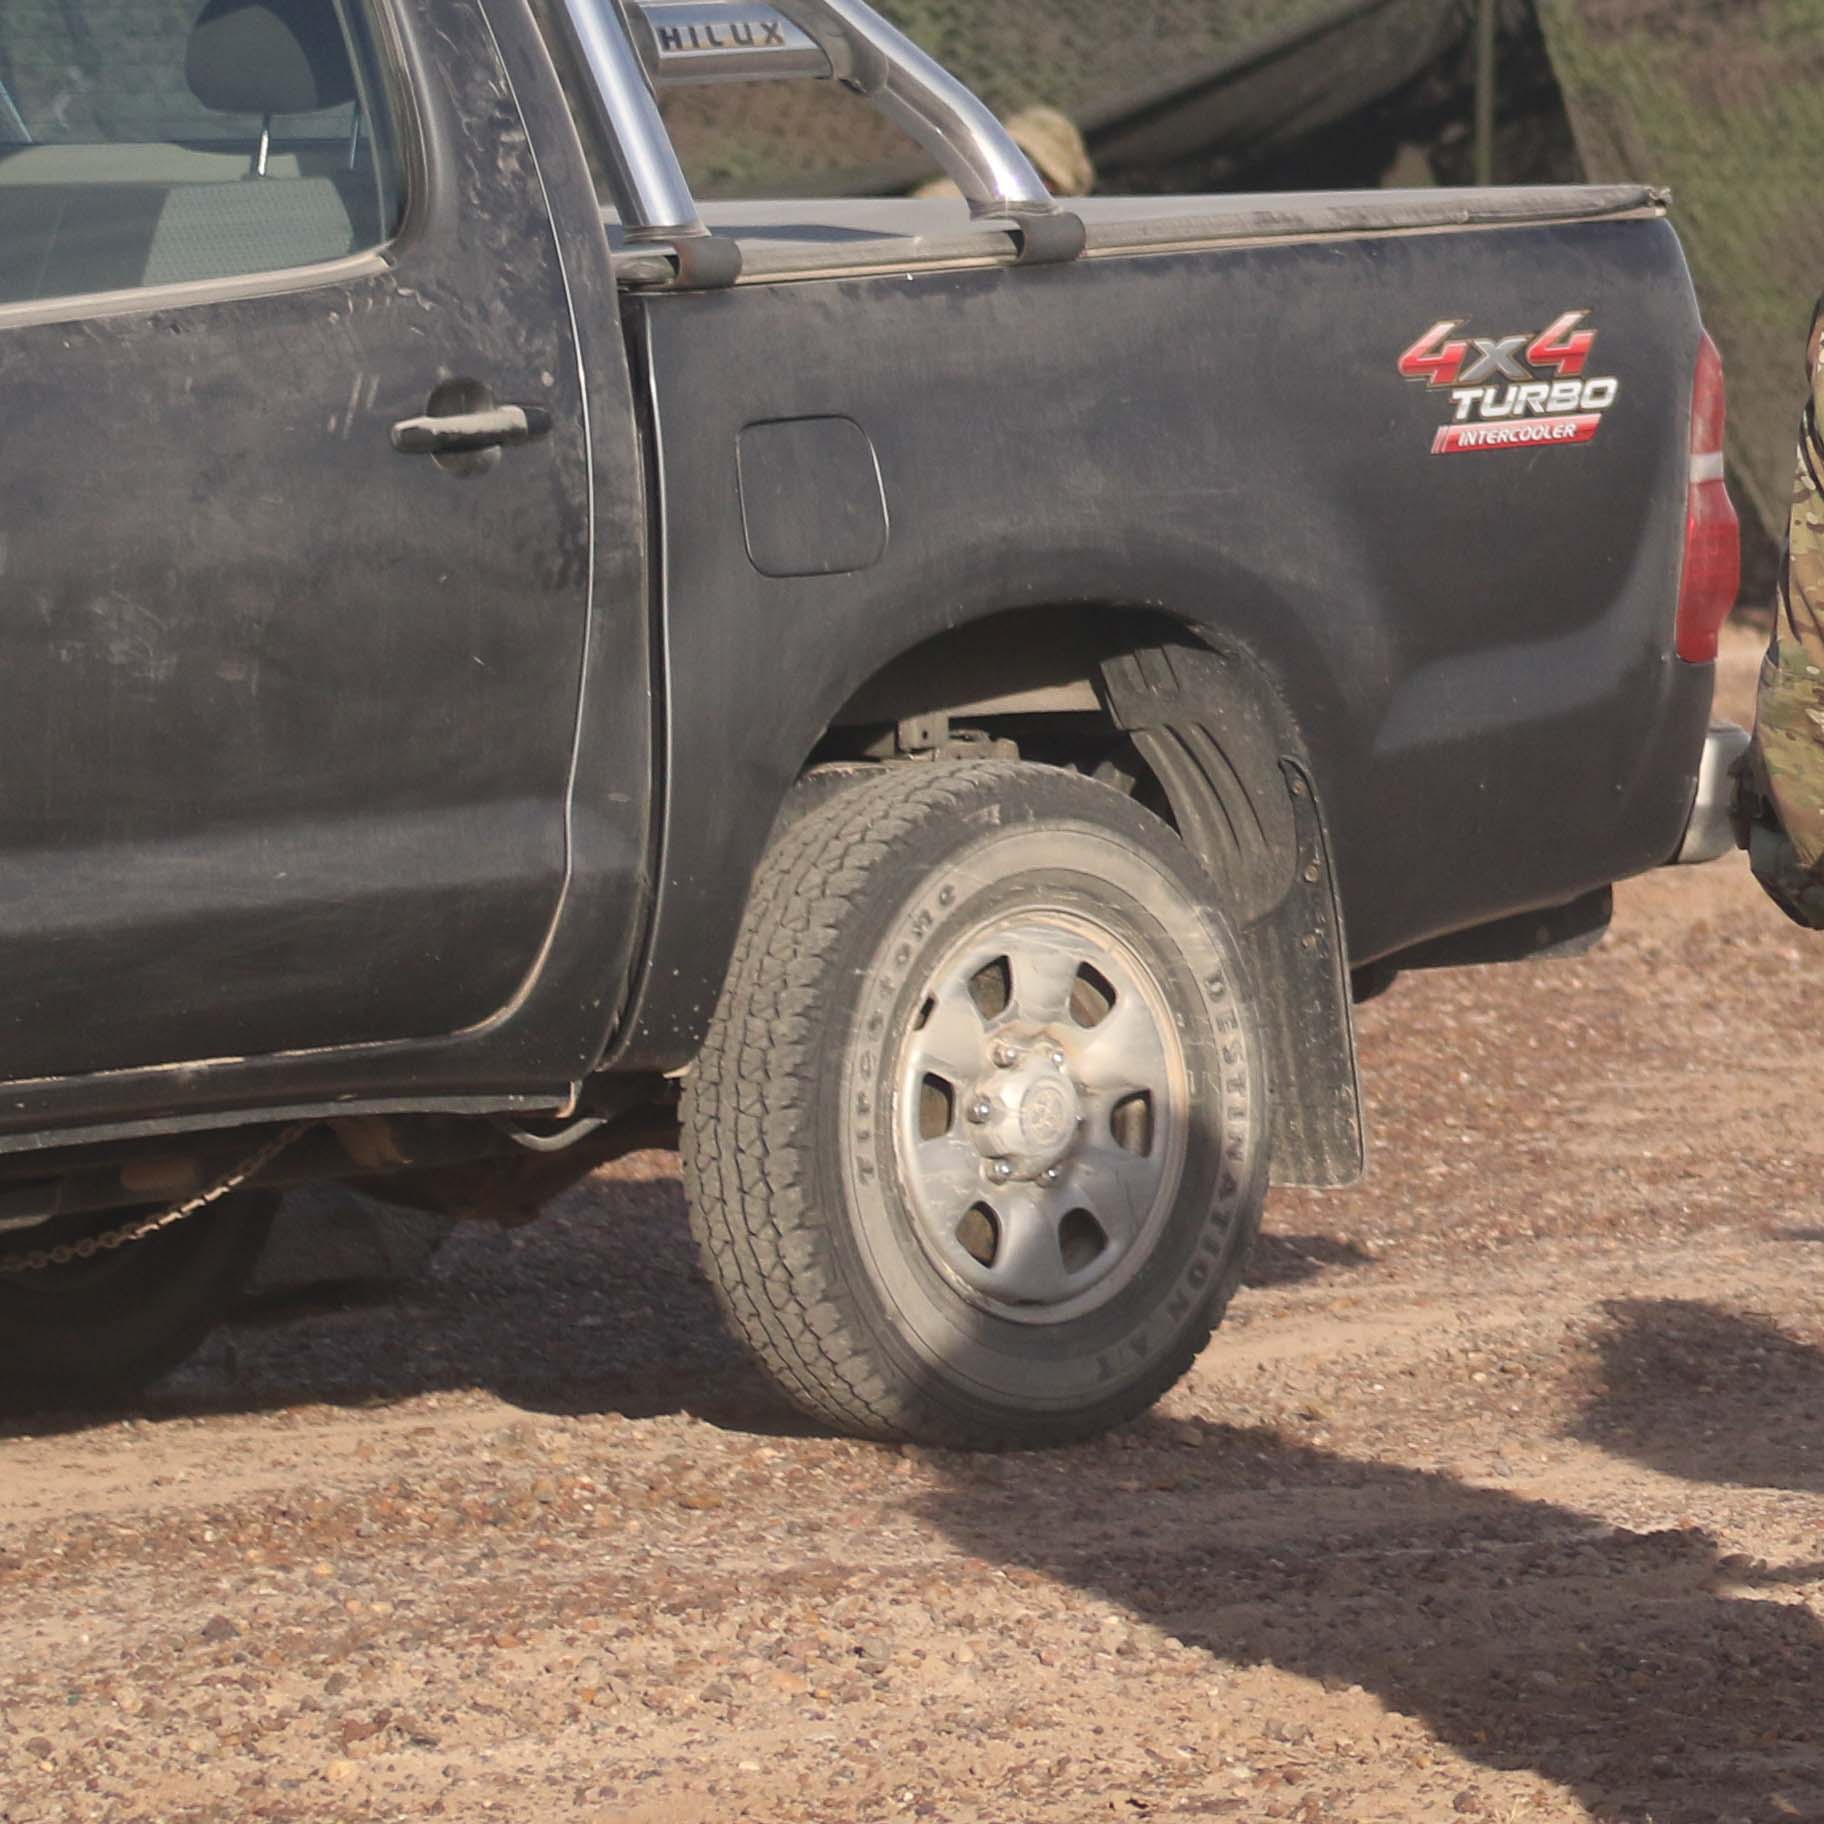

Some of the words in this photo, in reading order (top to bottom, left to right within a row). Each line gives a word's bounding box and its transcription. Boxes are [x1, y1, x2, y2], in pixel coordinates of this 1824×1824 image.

[658, 22, 785, 51] HILUX
[1450, 378, 1618, 421] TURBO
[1457, 423, 1577, 447] INTERCOOLER
[1167, 975, 1250, 1324] DESTINATION
